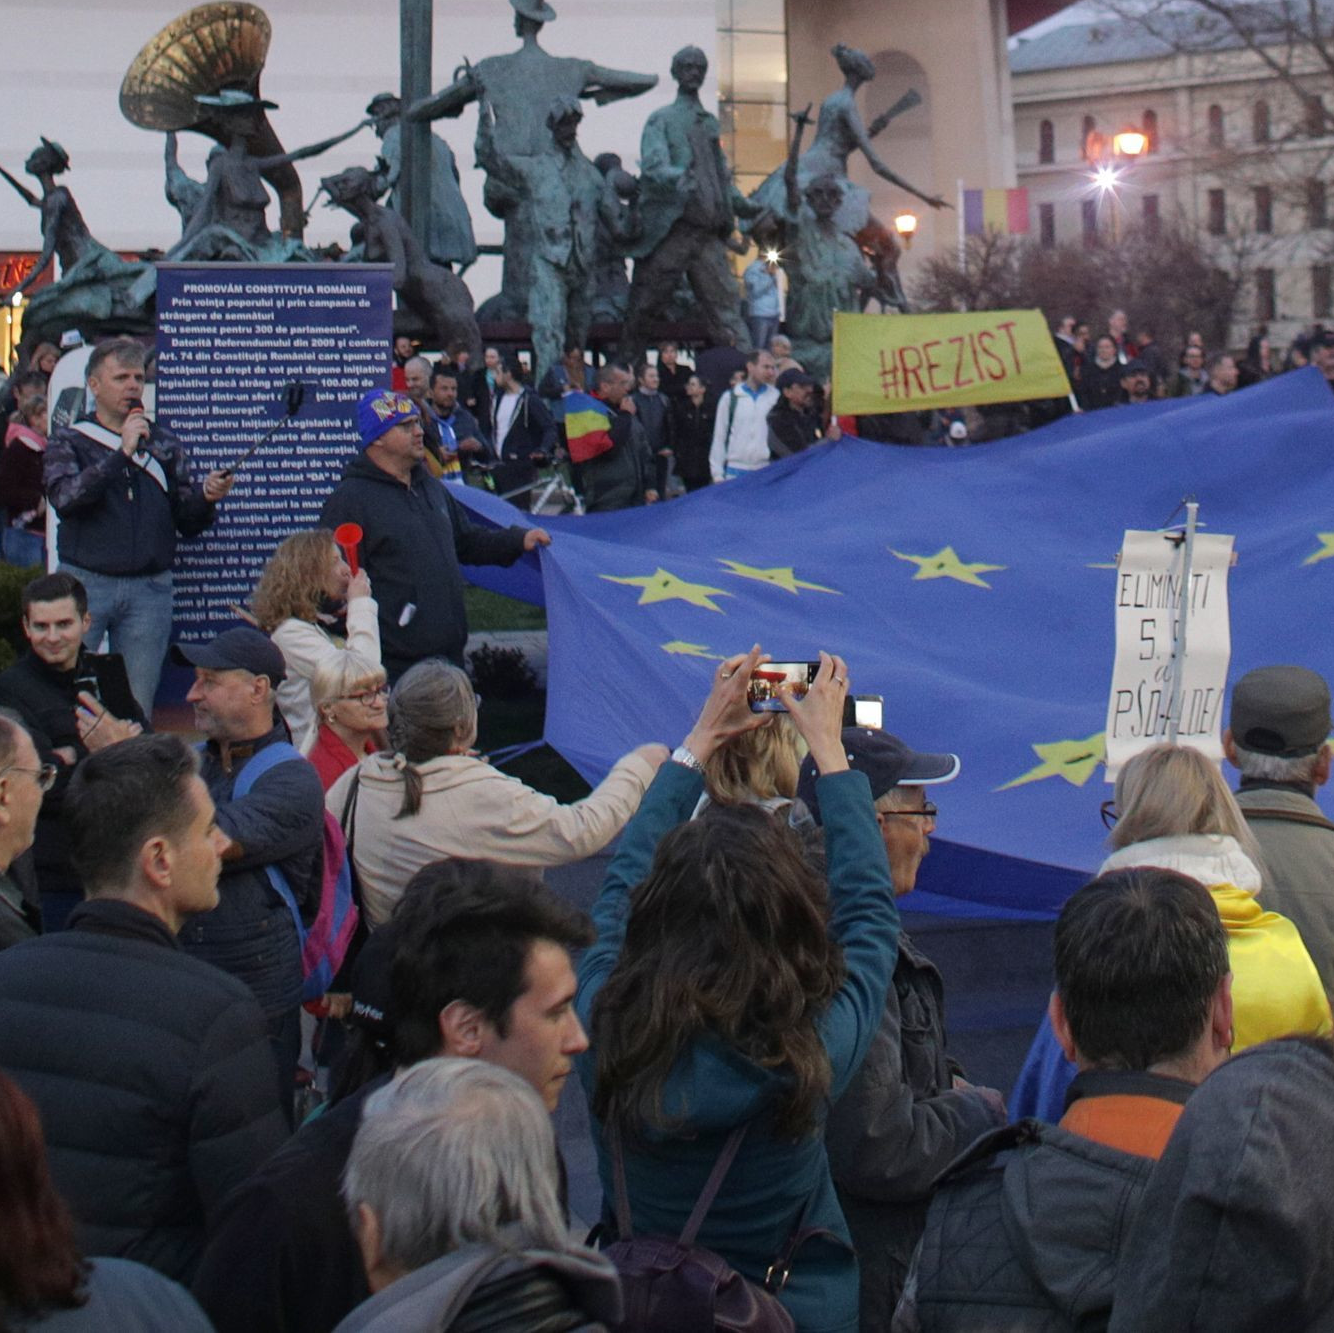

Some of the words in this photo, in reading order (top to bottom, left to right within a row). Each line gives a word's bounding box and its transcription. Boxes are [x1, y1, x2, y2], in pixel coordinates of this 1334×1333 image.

[183, 283, 243, 293] PROMOVĂM
[172, 297, 192, 308] Prin
[287, 297, 306, 310] prin
[308, 297, 356, 310] campania
[358, 297, 371, 308] de
[209, 311, 223, 321] de
[220, 324, 252, 336] pentru
[275, 324, 288, 334] de
[293, 337, 309, 348] din
[348, 337, 389, 348] conform
[159, 351, 178, 361] Art.
[195, 351, 211, 361] din
[879, 321, 1021, 399] #REZIST
[210, 366, 223, 374] cu
[225, 364, 252, 376] drept
[254, 364, 267, 374] de
[206, 419, 239, 430] pentru
